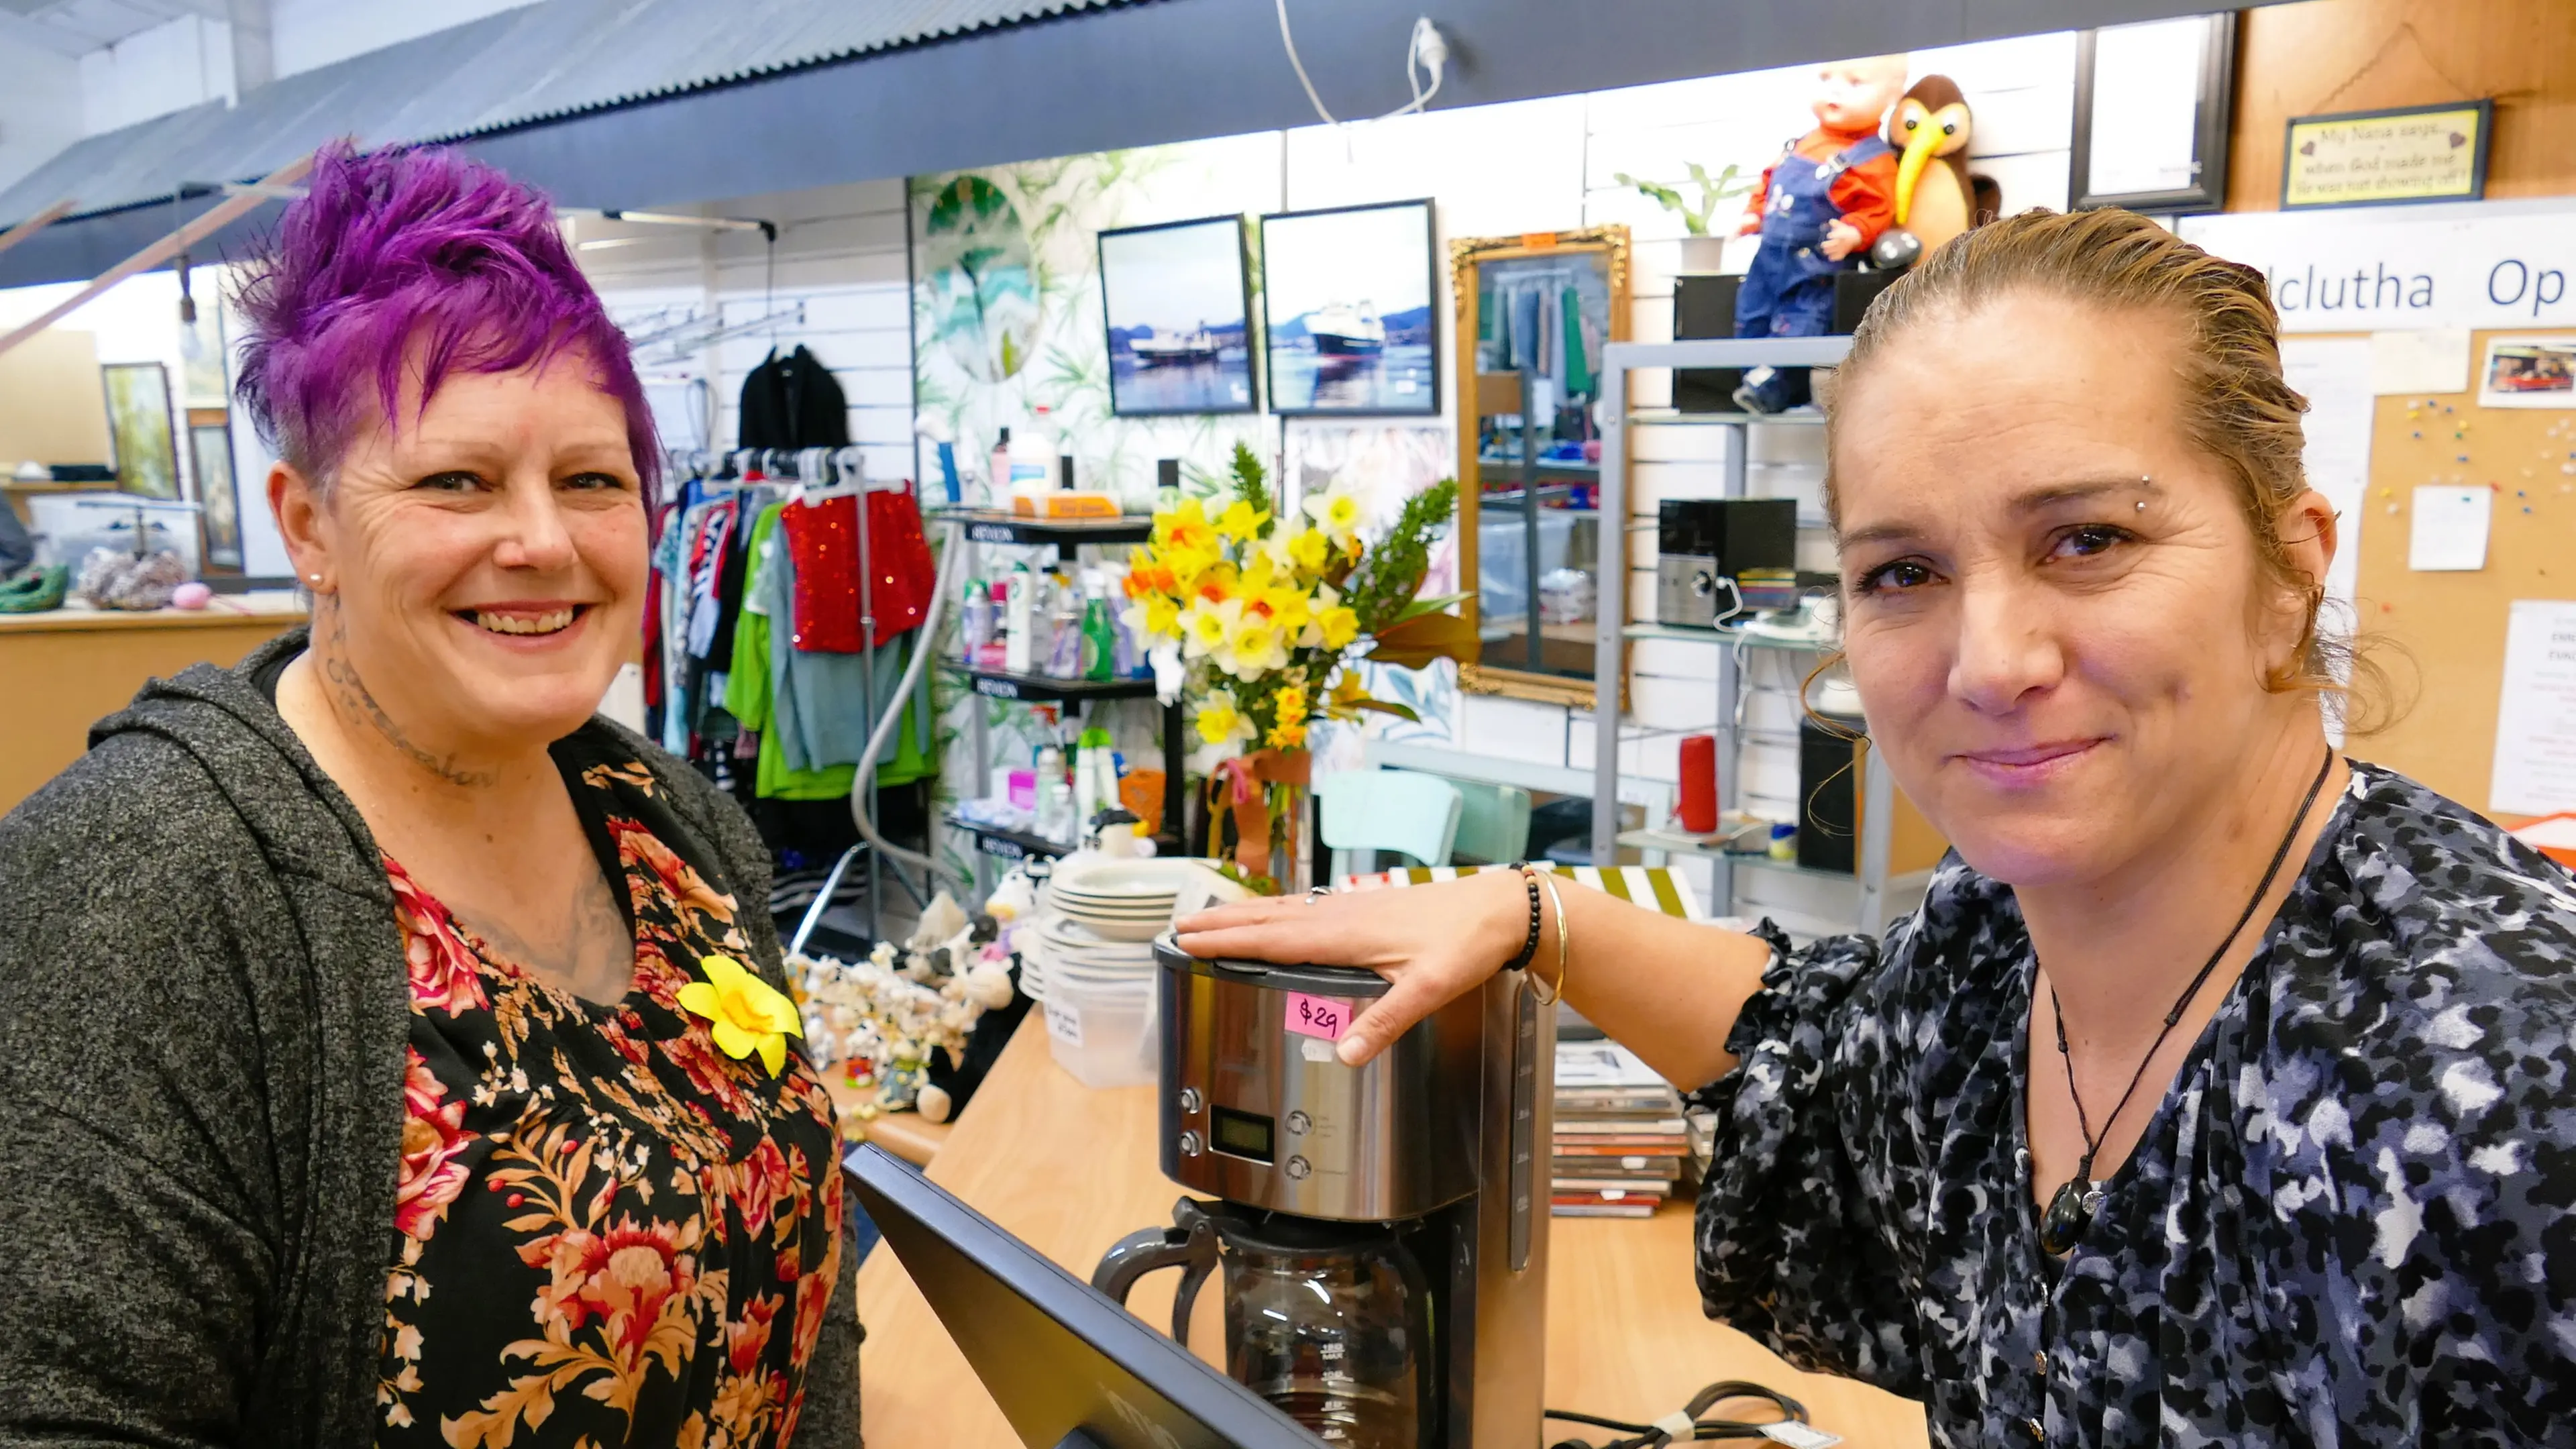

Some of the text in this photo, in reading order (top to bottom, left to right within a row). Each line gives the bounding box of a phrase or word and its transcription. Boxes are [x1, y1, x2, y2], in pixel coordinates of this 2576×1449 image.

[2321, 129, 2346, 144] My
[2352, 125, 2394, 140] Nana
[2349, 154, 2381, 172] God
[2385, 154, 2426, 168] made
[2432, 154, 2456, 166] me
[2487, 259, 2565, 317] Op
[1300, 998, 1338, 1038] $29
